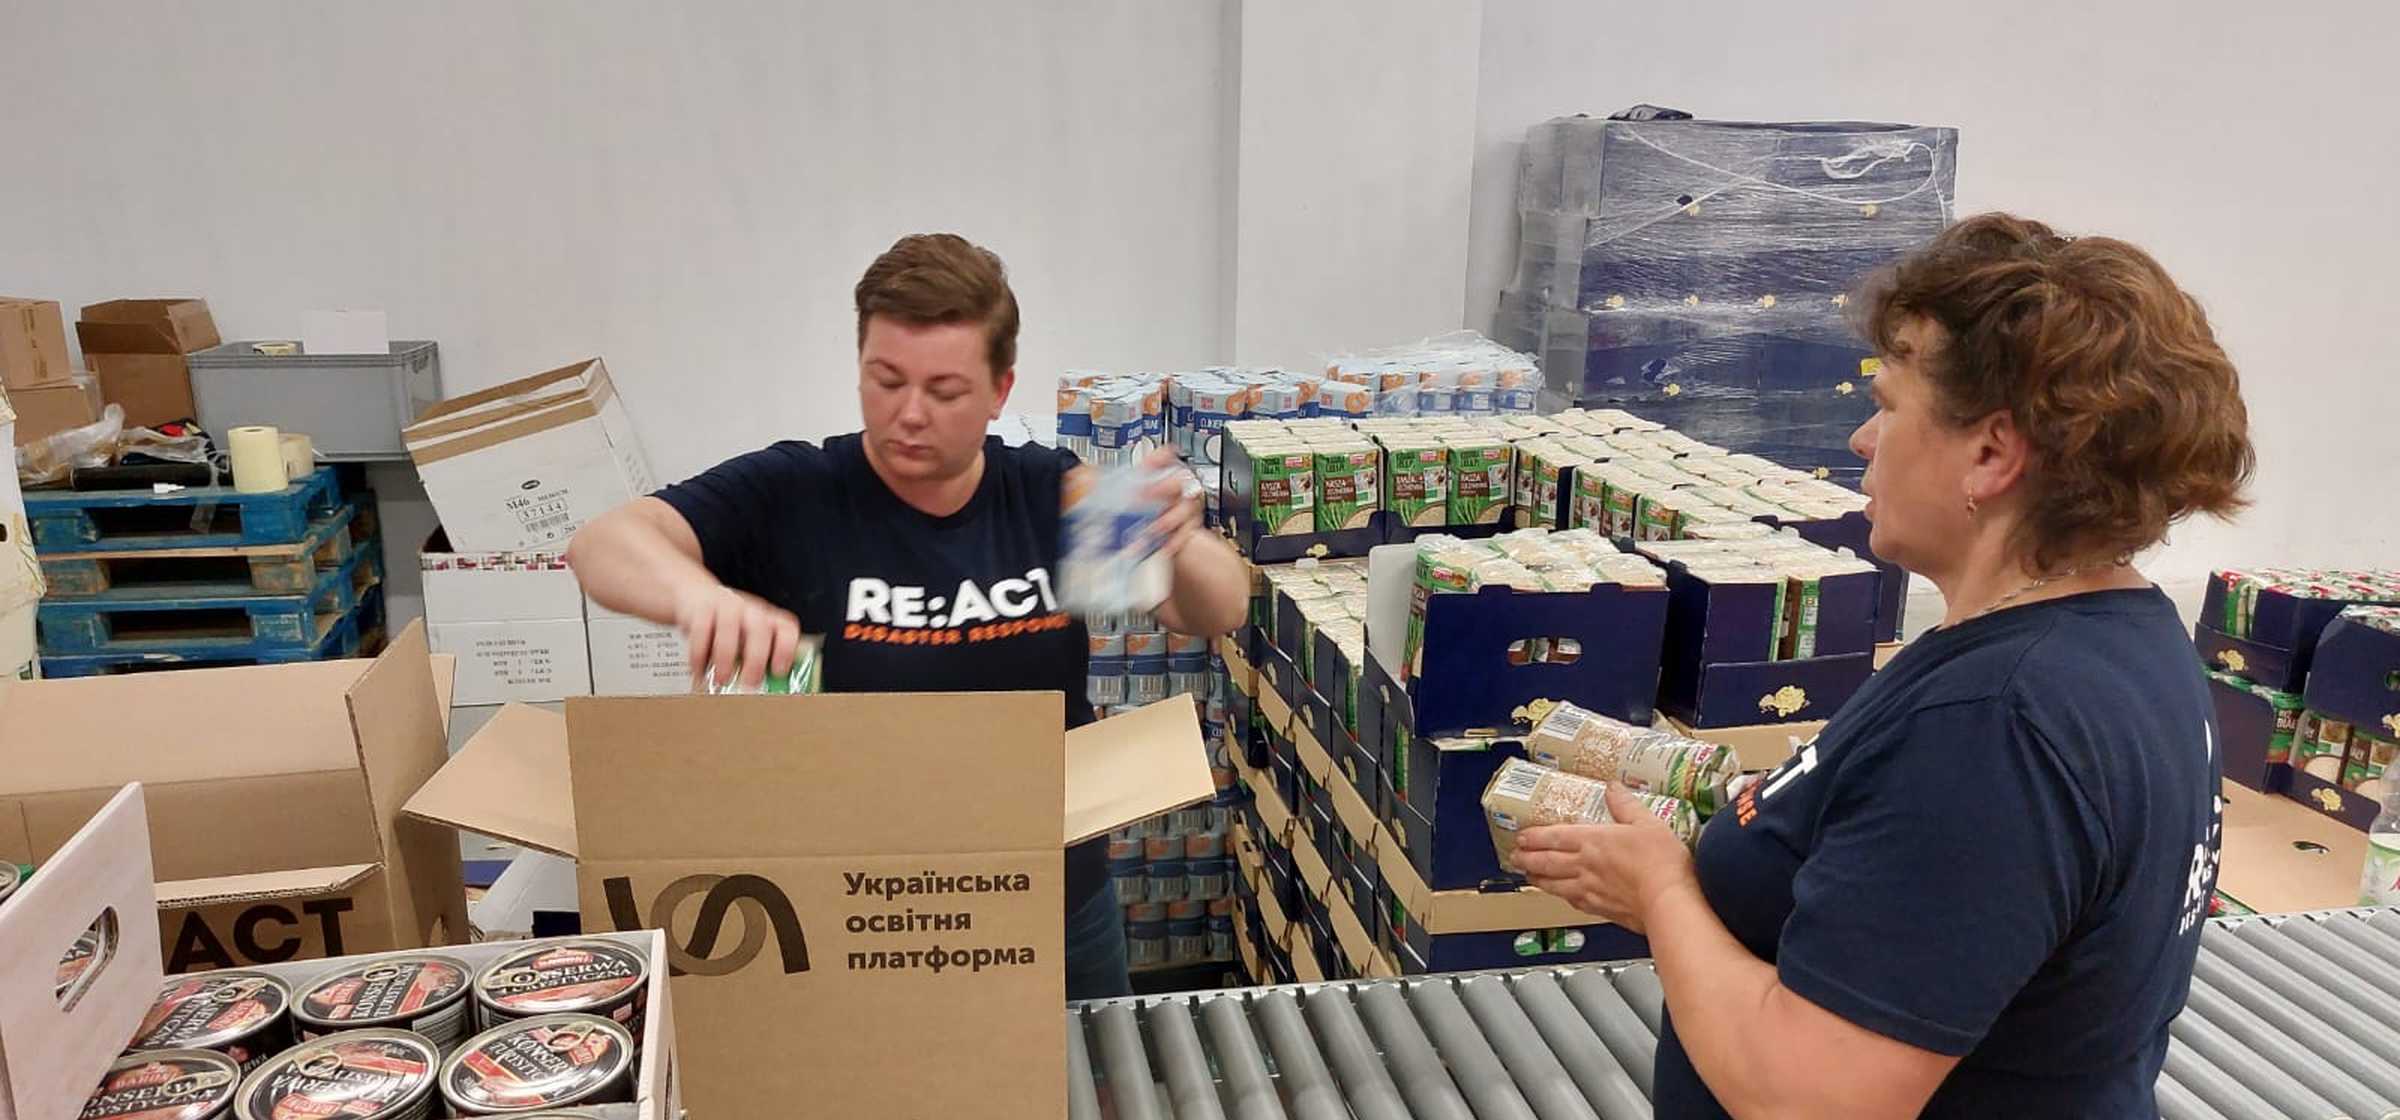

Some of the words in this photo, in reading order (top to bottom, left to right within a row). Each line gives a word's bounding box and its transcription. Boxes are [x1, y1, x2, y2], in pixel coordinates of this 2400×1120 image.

[846, 567, 1058, 628] RE:ACT
[843, 622, 961, 645] DISASTER
[967, 611, 1071, 642] RESPONS
[842, 870, 1031, 901] Українська
[845, 909, 972, 933] освітня
[847, 944, 1036, 973] платформа
